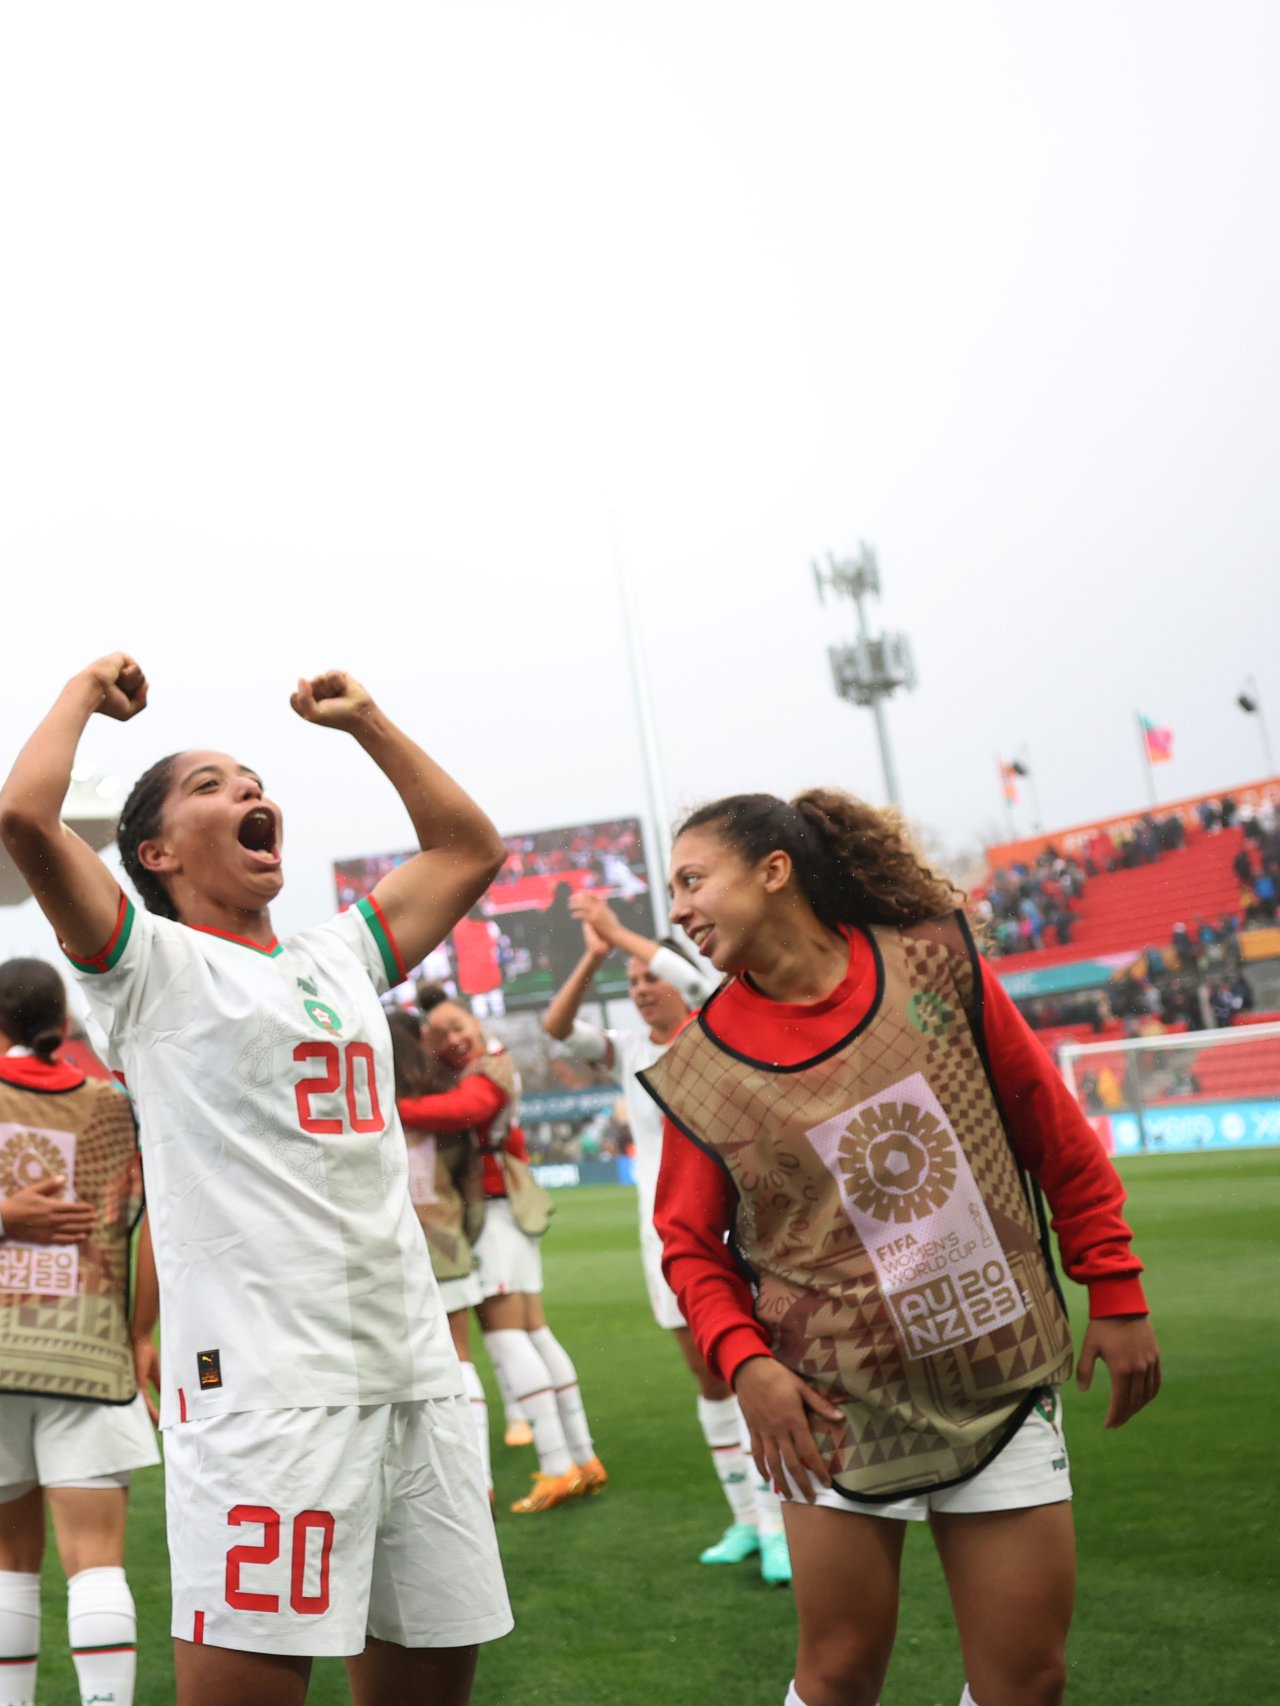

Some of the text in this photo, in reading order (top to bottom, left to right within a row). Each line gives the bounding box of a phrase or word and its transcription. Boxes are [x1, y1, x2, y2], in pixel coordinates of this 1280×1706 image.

[292, 1041, 386, 1134] 20
[36, 1252, 72, 1269] 20
[876, 1233, 918, 1262] FIFA
[884, 1232, 960, 1275] WOMEN'S
[889, 1240, 977, 1287] WORLD CUP
[35, 1271, 71, 1289] 23
[900, 1260, 1005, 1324] AU 20
[908, 1308, 966, 1351] NZ
[968, 1286, 1017, 1327] 23
[225, 1504, 335, 1615] 20
